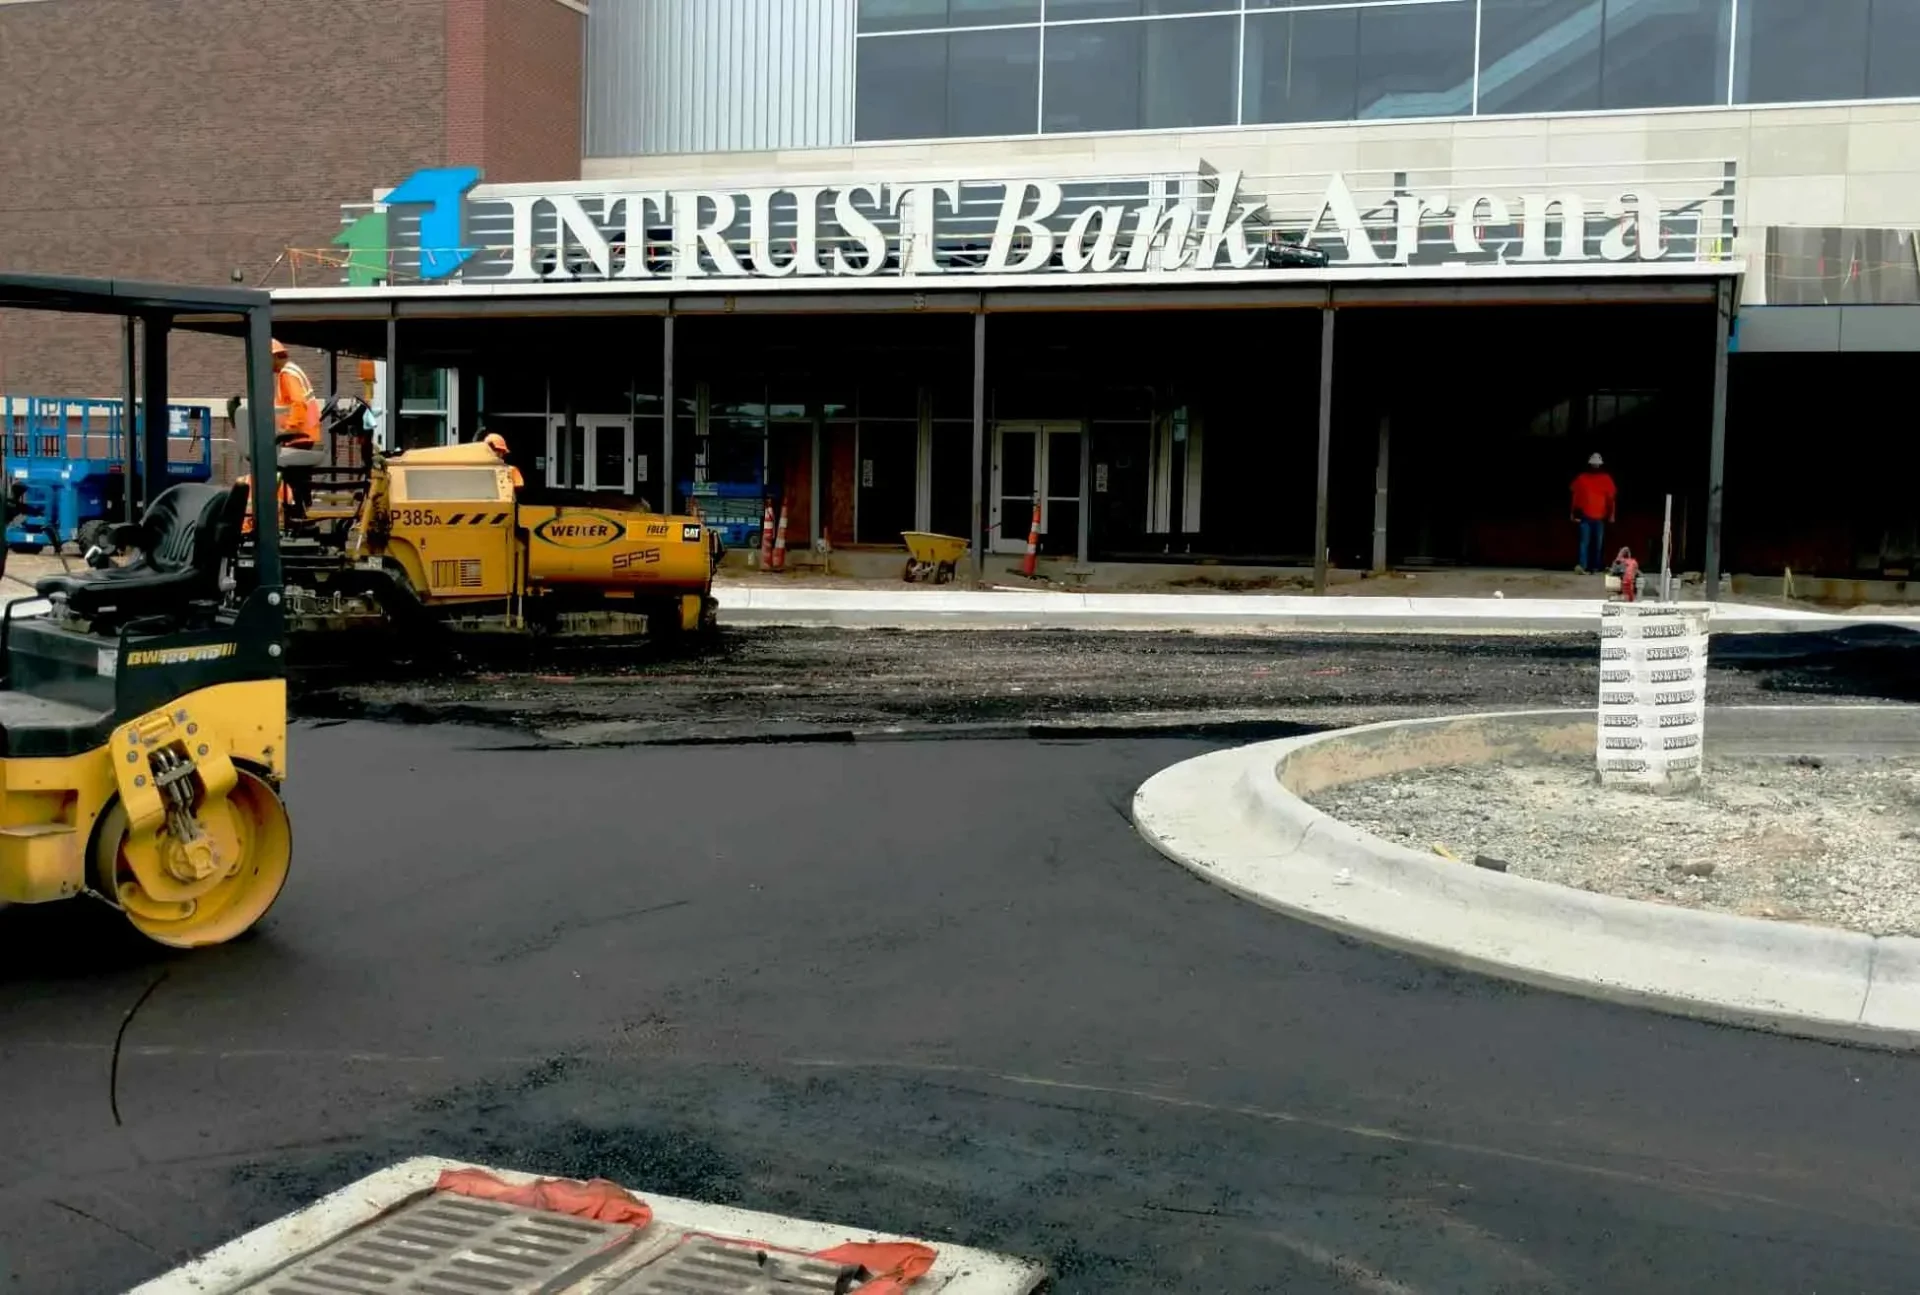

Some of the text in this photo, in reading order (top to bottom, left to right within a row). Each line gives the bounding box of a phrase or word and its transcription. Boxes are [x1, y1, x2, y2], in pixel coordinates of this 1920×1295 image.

[503, 171, 1671, 280] INTRUST Bank Arena
[551, 525, 608, 536] WEILER
[684, 527, 699, 538] CAT
[612, 548, 660, 569] SPS
